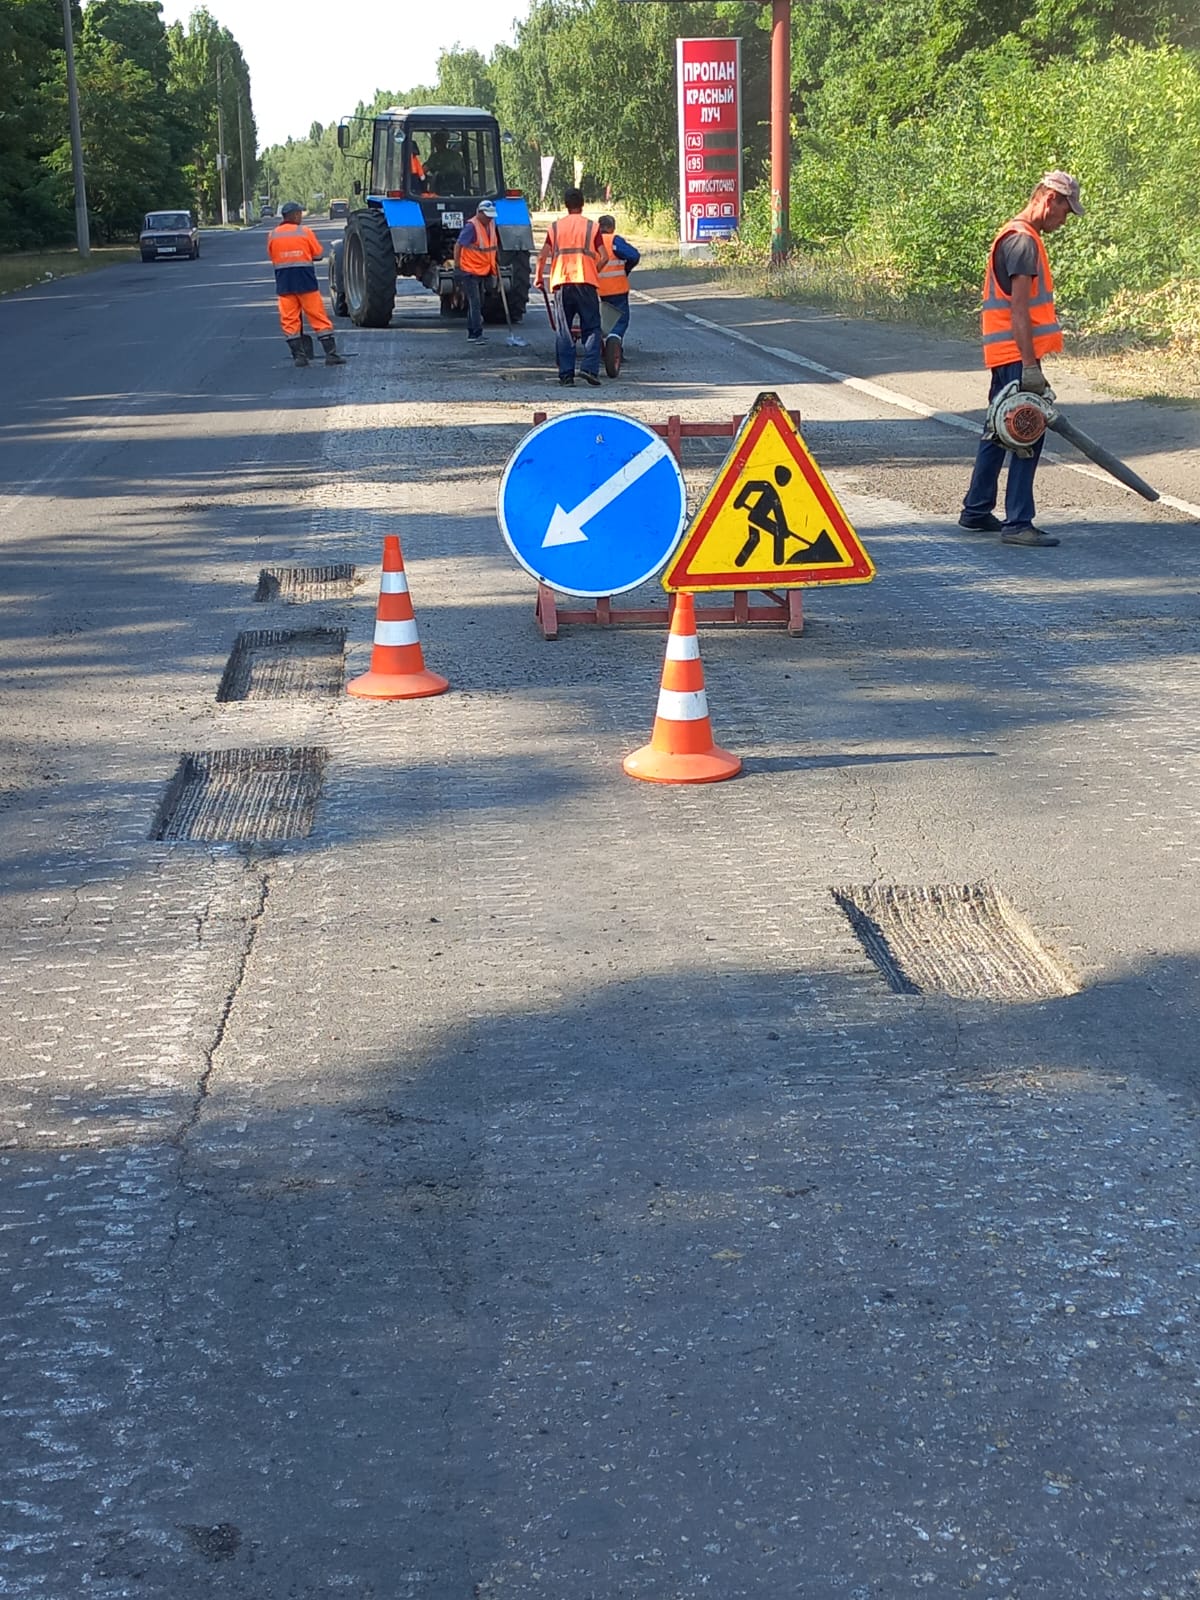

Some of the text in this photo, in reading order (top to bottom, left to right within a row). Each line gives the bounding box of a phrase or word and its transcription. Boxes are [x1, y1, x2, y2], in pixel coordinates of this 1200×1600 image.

[684, 61, 735, 82] ПРОПАН
[686, 85, 734, 104] КРАСНЫЙ
[700, 107, 720, 123] ЛУЧ
[687, 136, 701, 147] ГАЗ
